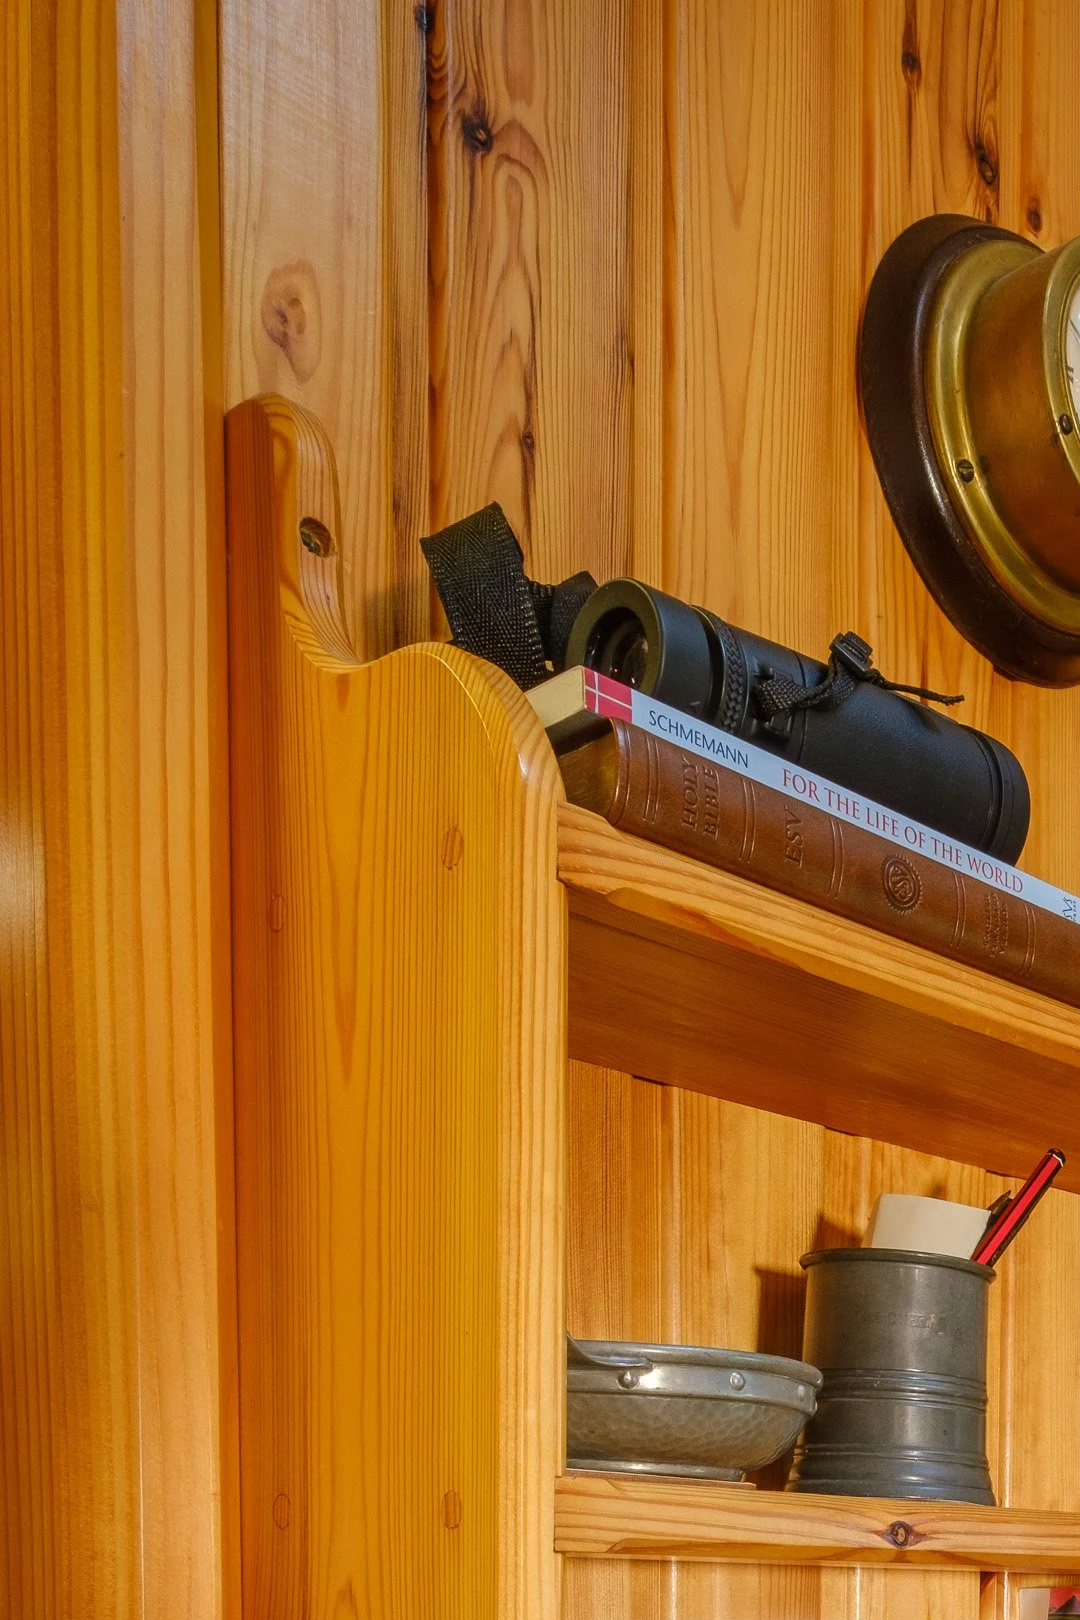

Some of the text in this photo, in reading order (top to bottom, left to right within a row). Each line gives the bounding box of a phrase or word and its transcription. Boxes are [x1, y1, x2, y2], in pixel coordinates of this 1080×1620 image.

[649, 710, 1024, 893] SCHMEMANN FOR THE LIFE OF THE WORLD
[682, 755, 699, 831] HOLY
[703, 764, 720, 840] BIBLE
[784, 803, 804, 869] ESV
